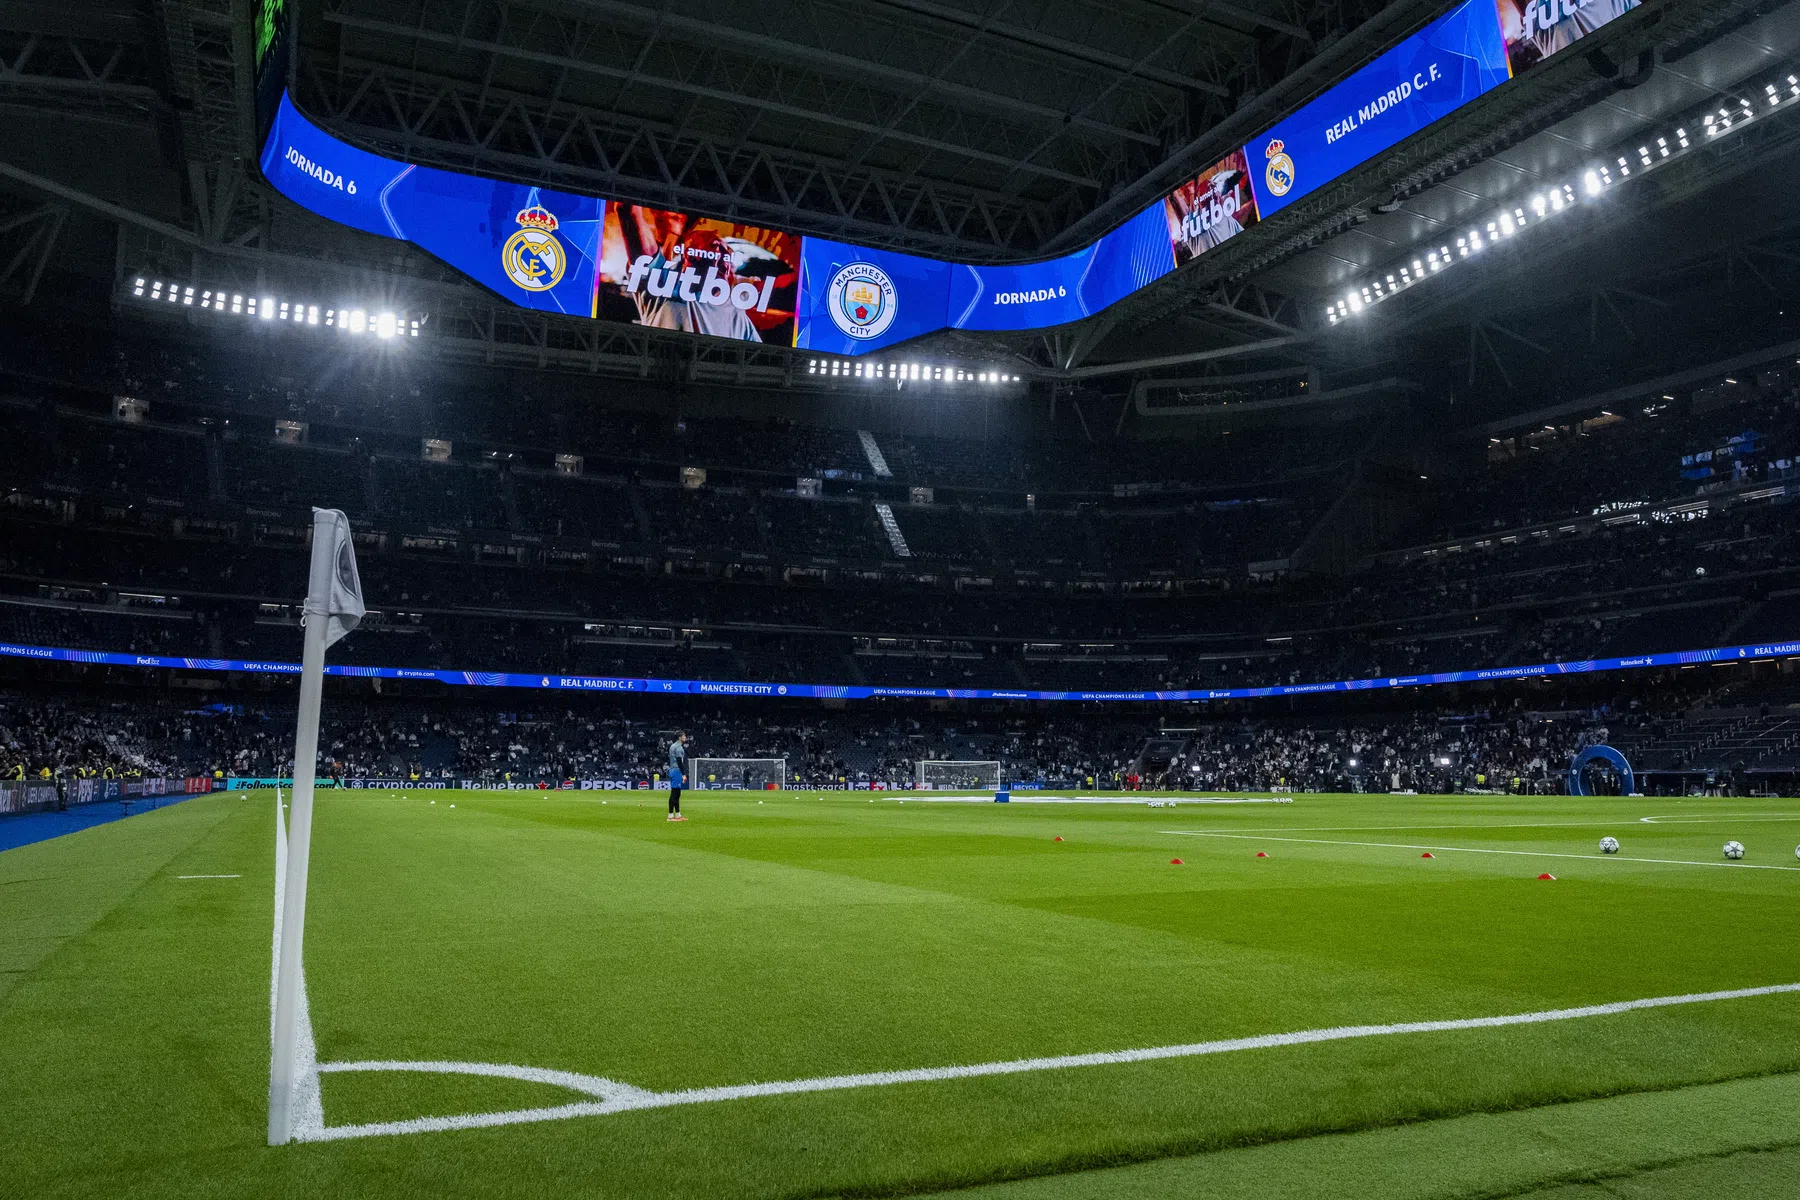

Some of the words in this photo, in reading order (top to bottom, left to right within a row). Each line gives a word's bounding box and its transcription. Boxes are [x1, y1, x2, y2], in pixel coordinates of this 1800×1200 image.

[1325, 115, 1358, 144] REAL
[1358, 81, 1412, 125] MADRID
[1413, 73, 1428, 90] C.
[1428, 63, 1441, 82] F.
[285, 145, 344, 191] JORNADA
[347, 180, 357, 195] 6
[1180, 183, 1241, 243] fútbol
[673, 243, 684, 255] el
[687, 247, 720, 260] amor
[627, 255, 776, 313] fútbol
[835, 266, 893, 296] MANCHESTER
[993, 287, 1057, 305] JORNADA
[1058, 285, 1067, 297] 6
[849, 326, 871, 336] CITY
[26, 649, 53, 658] LEAGUE
[1754, 646, 1773, 655] REAL
[263, 663, 304, 672] CHAMPIONS
[1491, 668, 1524, 677] CHAMPIONS
[1523, 666, 1545, 674] LEAGUE
[560, 678, 583, 688] REAL
[583, 679, 618, 689] MADRID
[618, 681, 627, 689] C.
[627, 681, 634, 690] F.
[662, 682, 673, 691] VS
[700, 683, 753, 693] MANCHESTER
[753, 685, 772, 694] CITY
[368, 780, 446, 790] crypto.com
[581, 780, 632, 790] PEPSI
